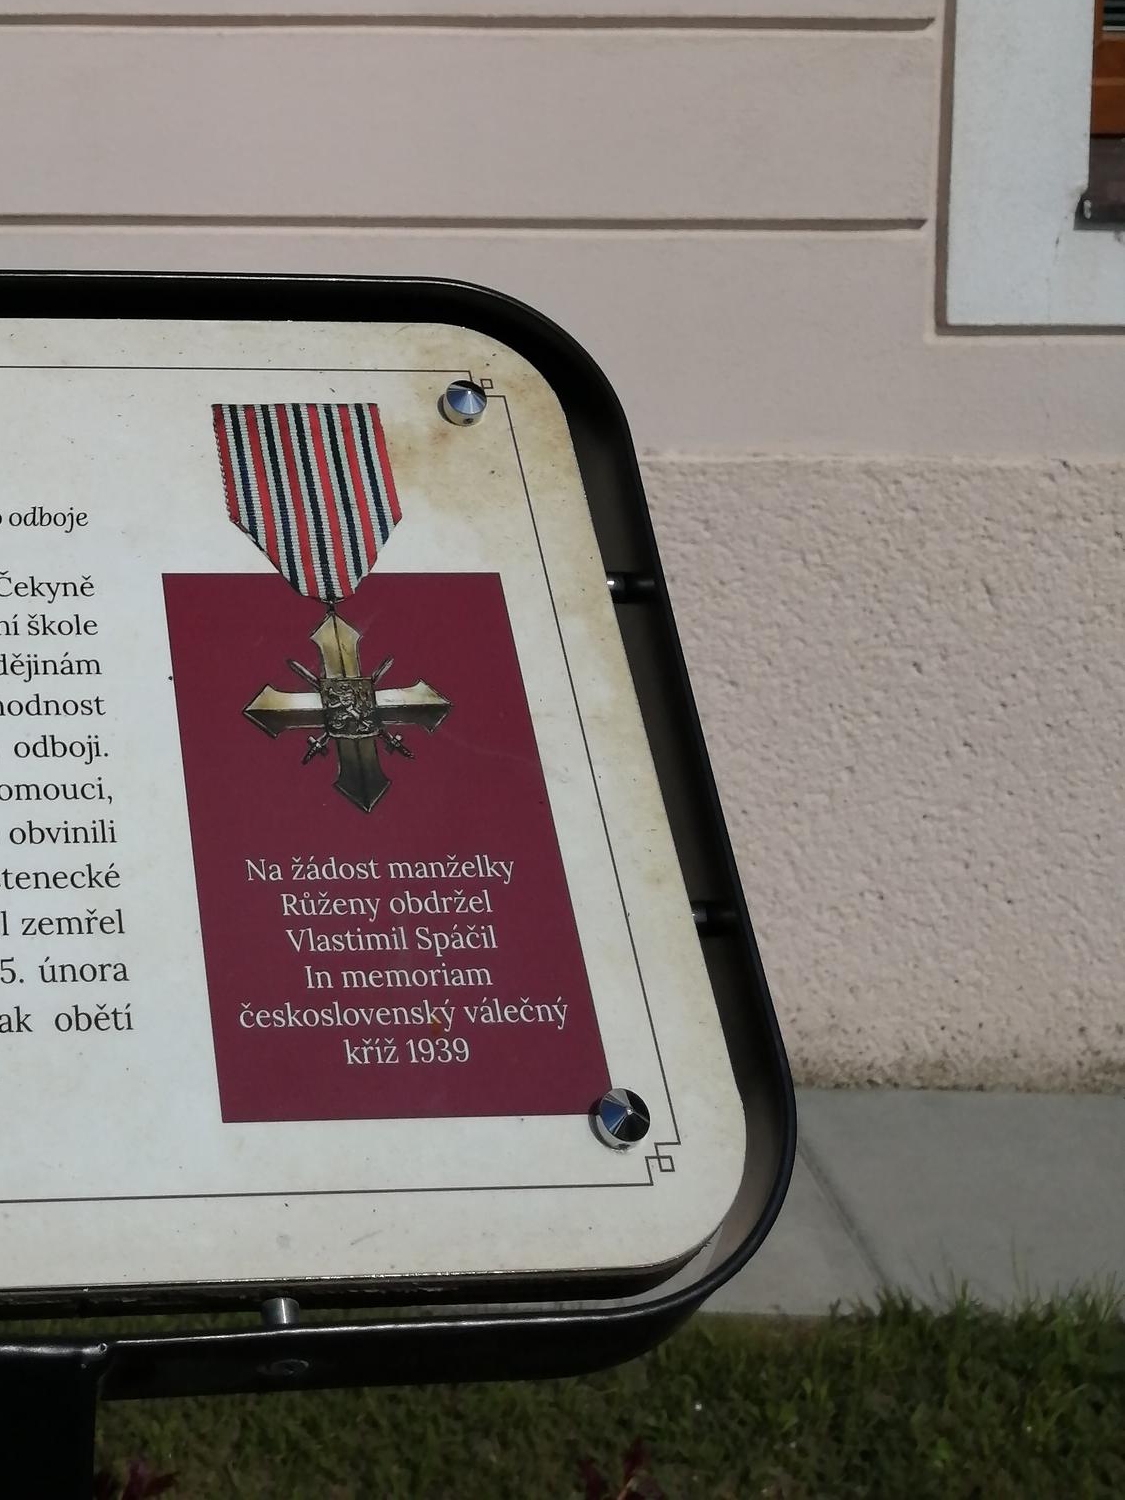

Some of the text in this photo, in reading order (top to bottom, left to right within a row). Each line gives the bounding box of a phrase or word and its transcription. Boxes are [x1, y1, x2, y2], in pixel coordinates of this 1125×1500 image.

[9, 506, 88, 533] odboje
[27, 614, 98, 636] škole
[14, 735, 108, 765] odboji.
[9, 819, 117, 845] obvinili
[245, 854, 514, 884] Na žádost manželky
[281, 890, 493, 922] Růženy obdržel
[22, 909, 125, 935] zemřel
[285, 924, 498, 957] Vlastimil Spáčil
[38, 956, 130, 983] února
[305, 963, 493, 988] In memoriam
[55, 1003, 133, 1032] obětí
[240, 996, 568, 1032] československý válečný
[343, 1038, 469, 1064] kříž 1939
